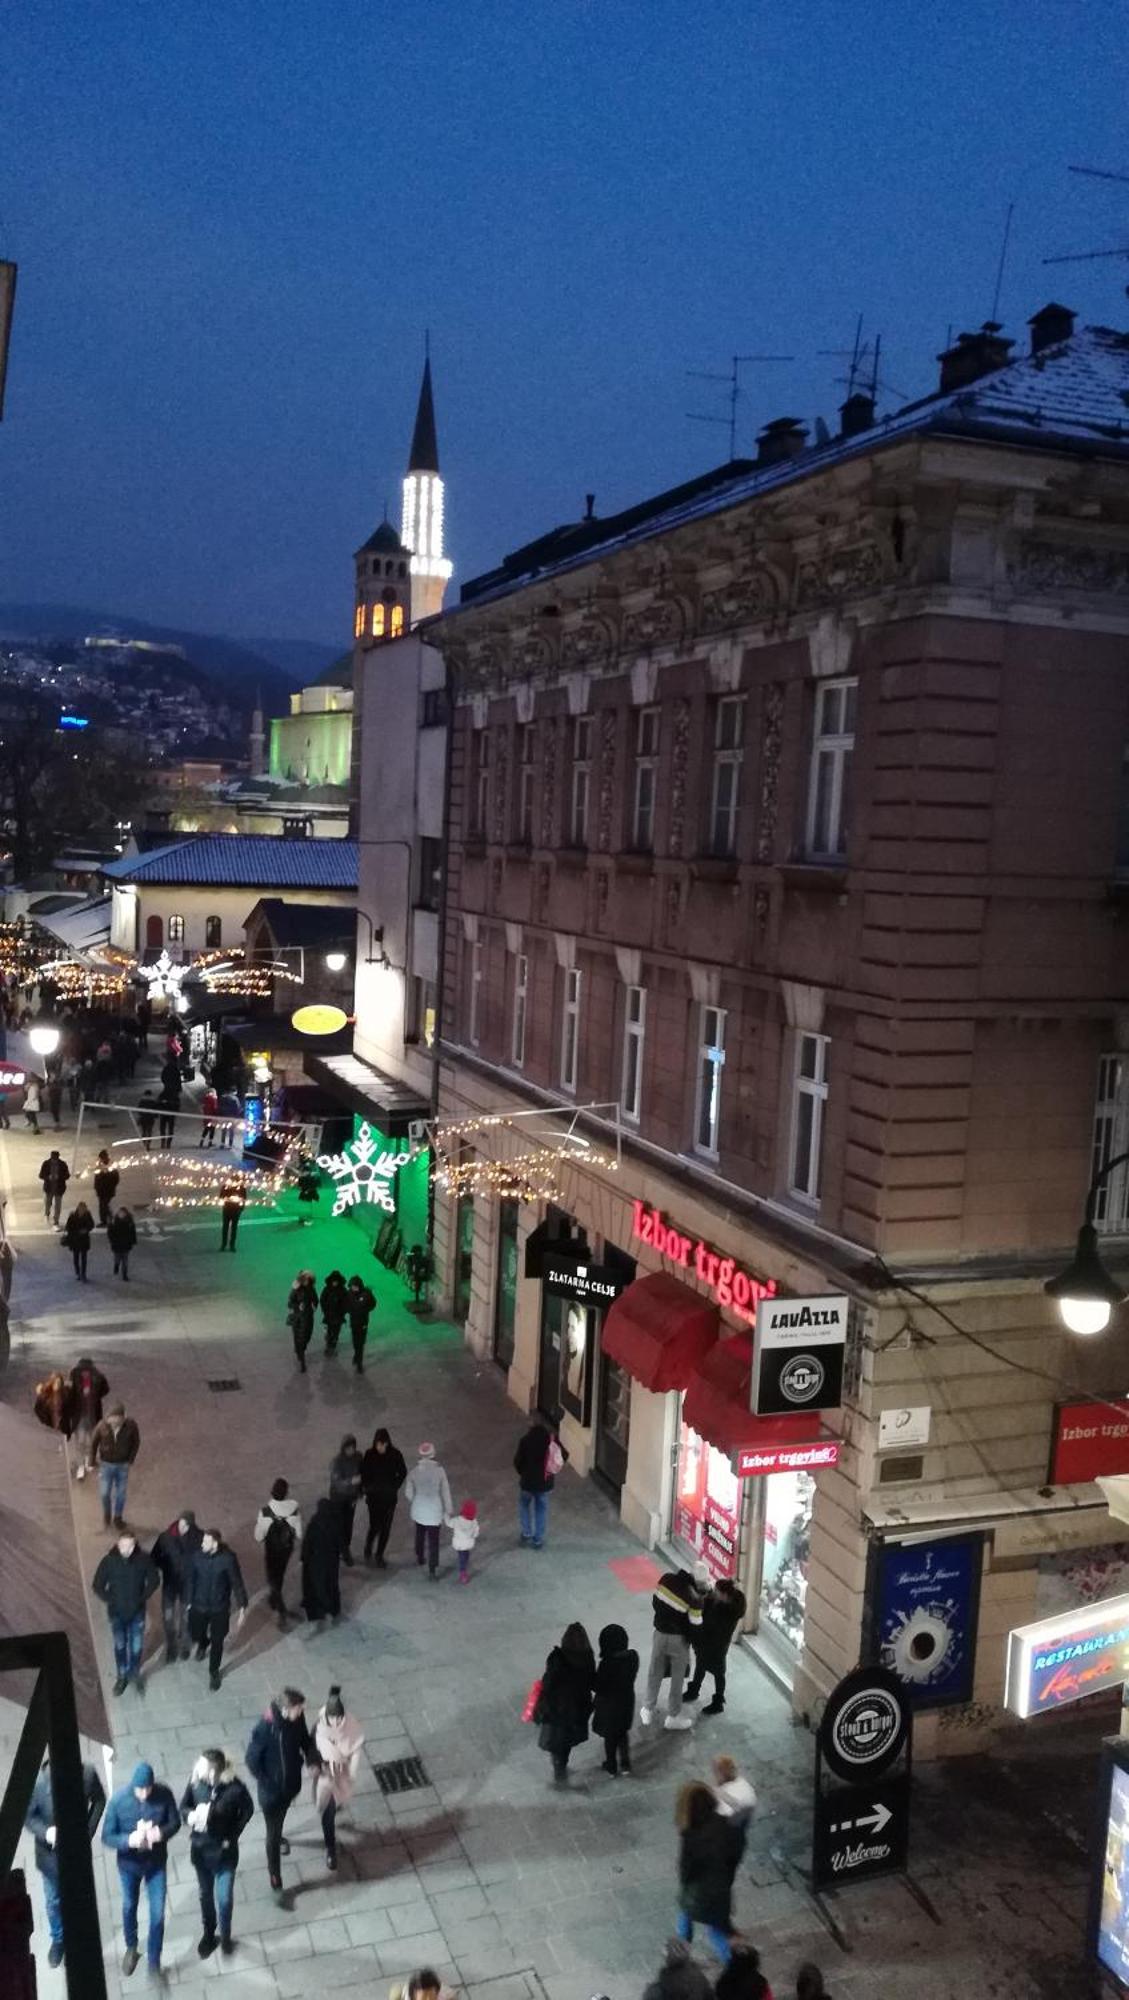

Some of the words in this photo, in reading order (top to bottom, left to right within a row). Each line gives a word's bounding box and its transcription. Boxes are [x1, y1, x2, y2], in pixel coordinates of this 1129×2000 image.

[633, 1200, 691, 1267] Izbor
[548, 1270, 590, 1290] ZLATARNA
[591, 1281, 616, 1297] CELJE
[1062, 1427, 1098, 1441] Izbor
[742, 1454, 777, 1469] Izbor
[831, 1842, 891, 1872] Welcome
